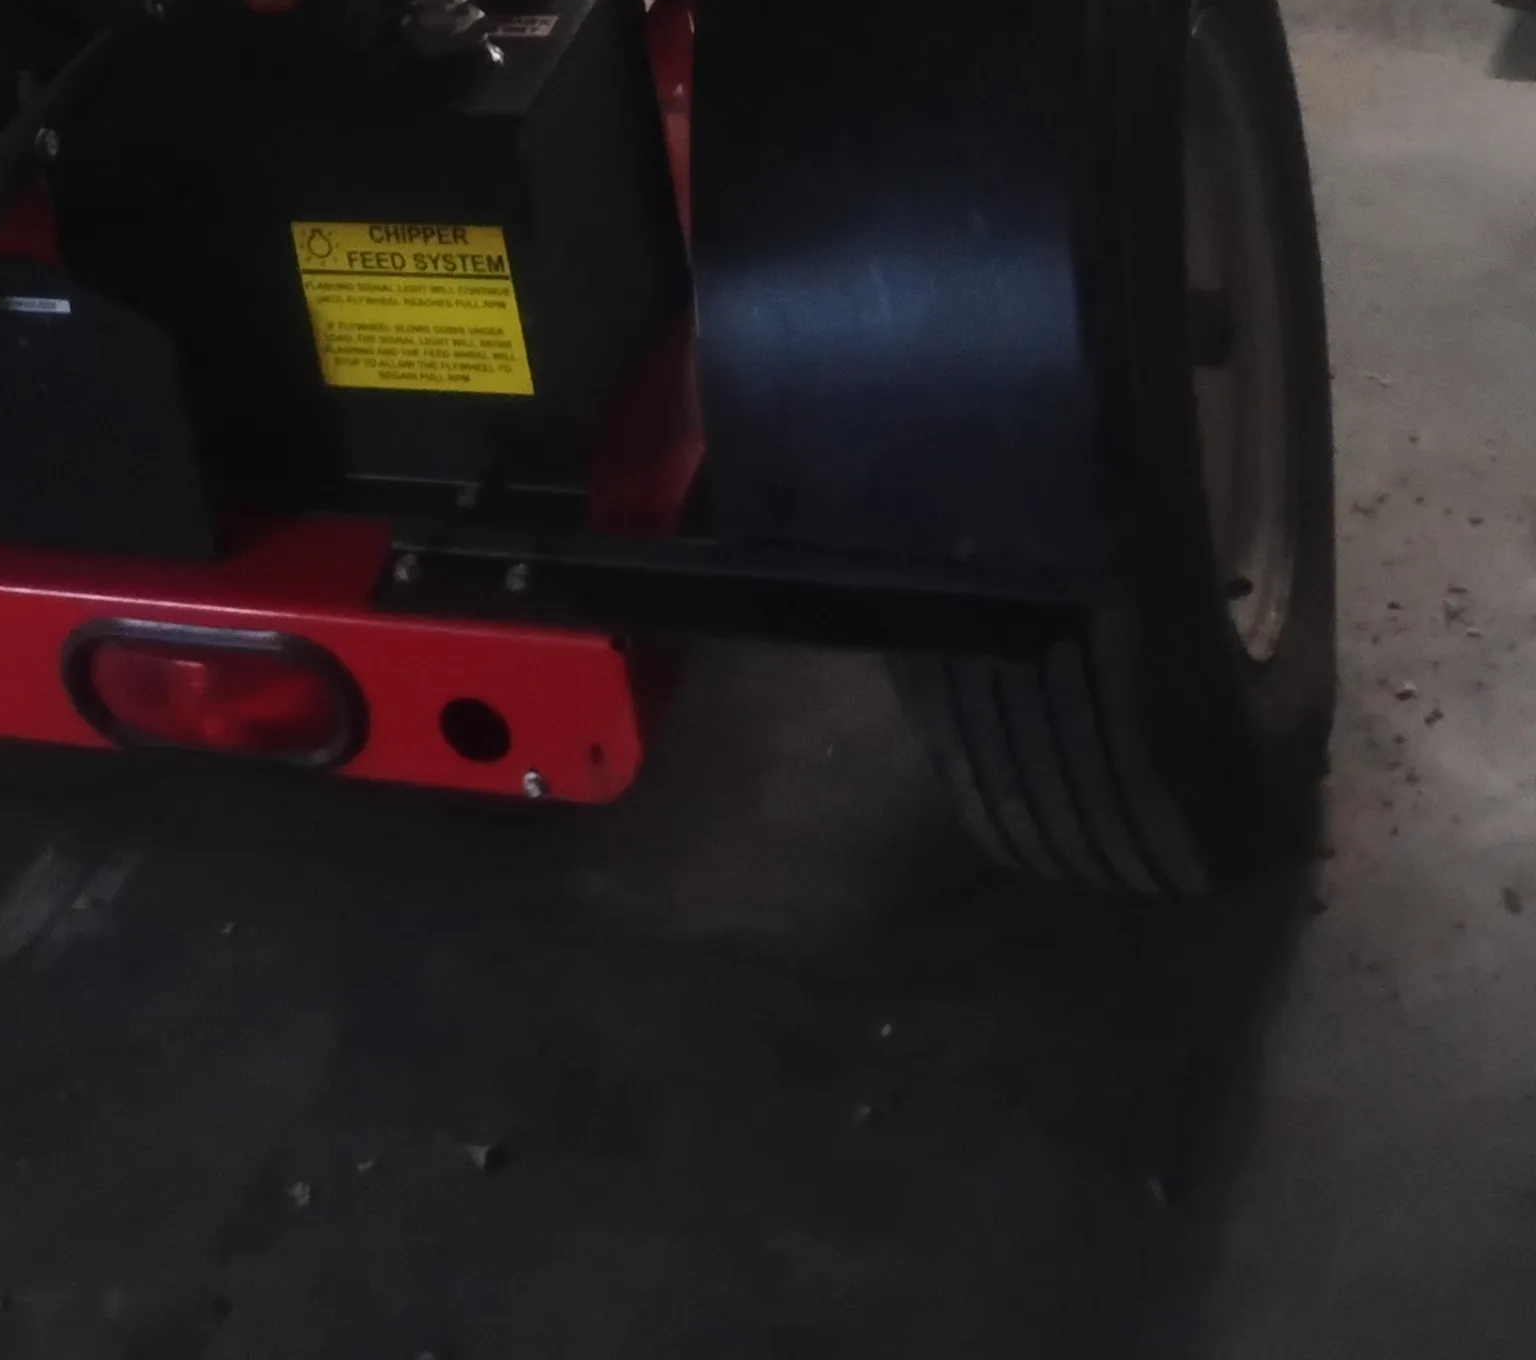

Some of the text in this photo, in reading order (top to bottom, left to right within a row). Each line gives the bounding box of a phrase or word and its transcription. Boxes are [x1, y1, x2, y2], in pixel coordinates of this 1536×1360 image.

[367, 225, 469, 246] CHIPPER
[346, 250, 506, 274] FEED SYSTEM
